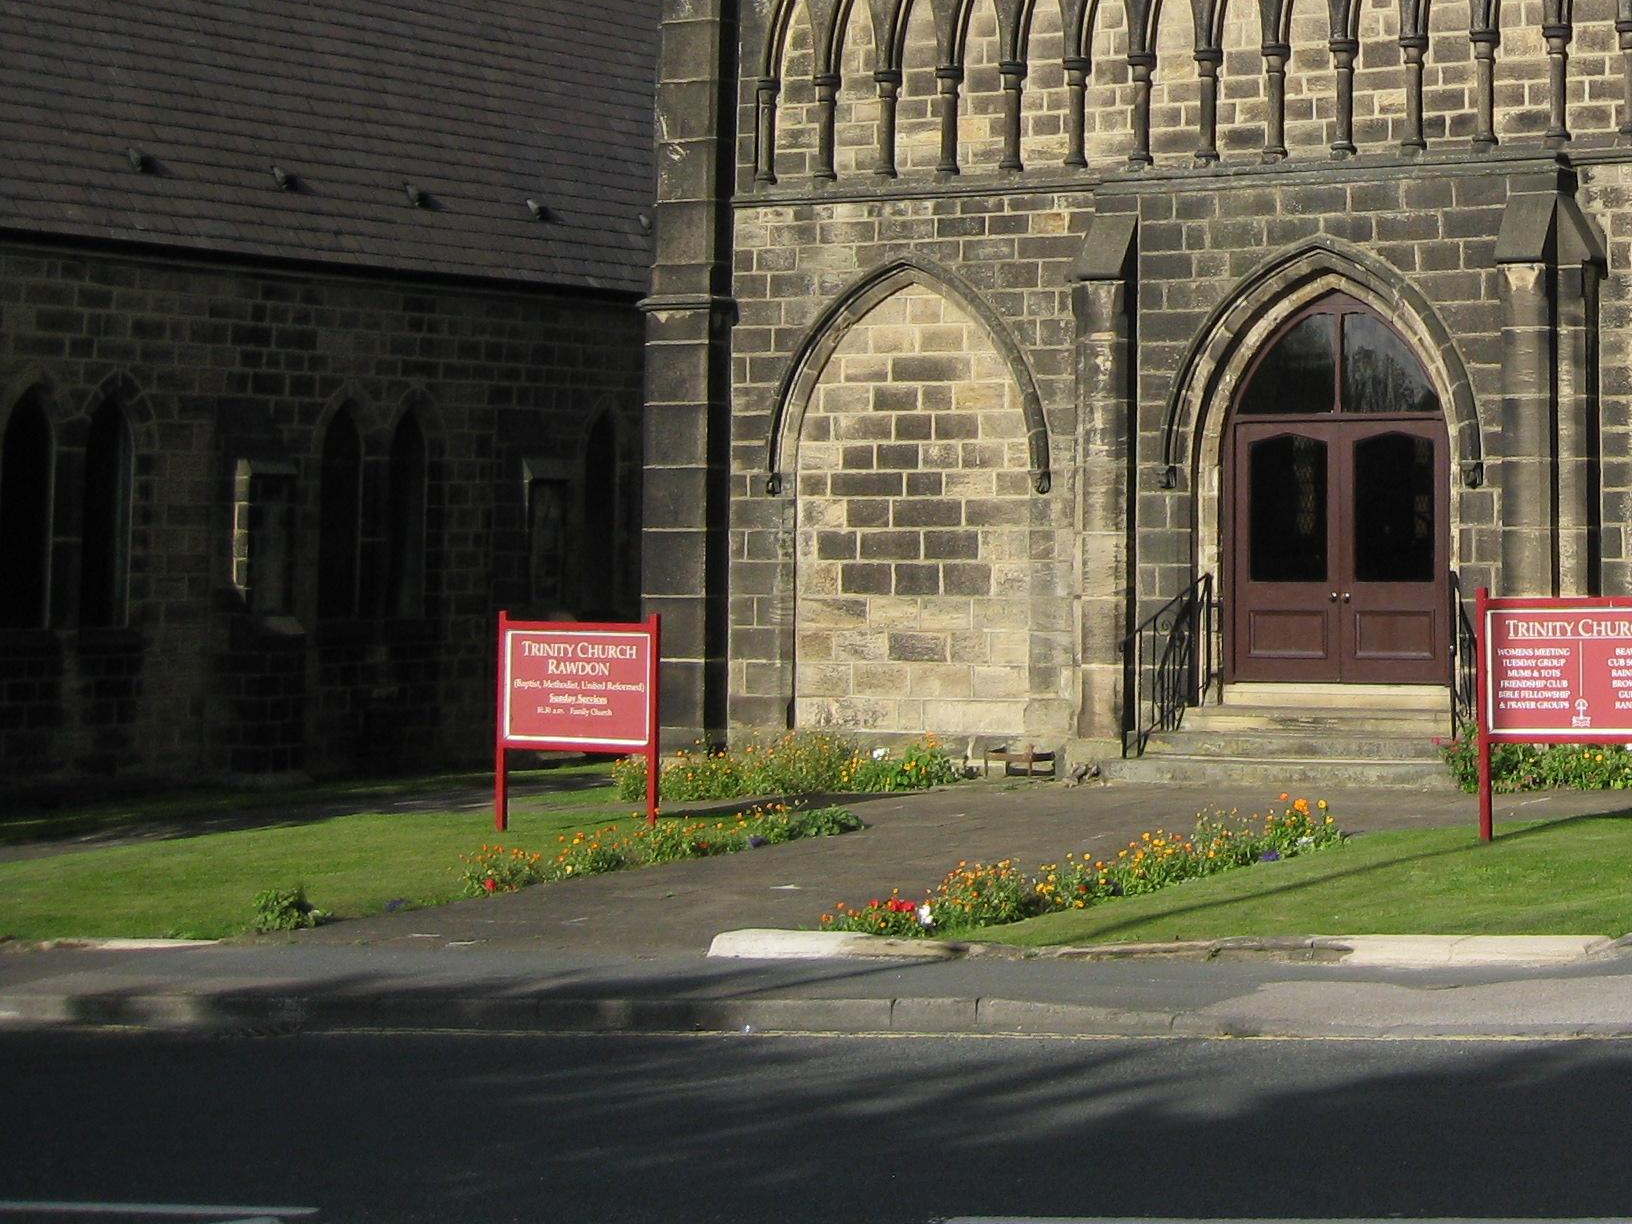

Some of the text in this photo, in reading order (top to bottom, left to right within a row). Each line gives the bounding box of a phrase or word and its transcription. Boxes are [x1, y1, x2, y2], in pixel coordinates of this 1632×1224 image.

[1506, 620, 1575, 637] TRINITY
[521, 640, 637, 659] TRINITY CHURCH
[1534, 647, 1571, 656] MEETING
[1503, 658, 1567, 667] TUESDAY GROUP
[1608, 658, 1625, 666] CUB
[547, 659, 610, 676] RAWDON
[1507, 669, 1561, 677] MUMS & TOTS
[581, 681, 605, 690] United
[1500, 679, 1568, 688] FRIENDSHIP CLUB
[549, 693, 608, 704] Sunday Services
[1520, 690, 1571, 699] FELLOWSHIP
[1507, 701, 1537, 709] PRAYER
[1537, 701, 1570, 709] GROUPS
[590, 708, 613, 716] Church
